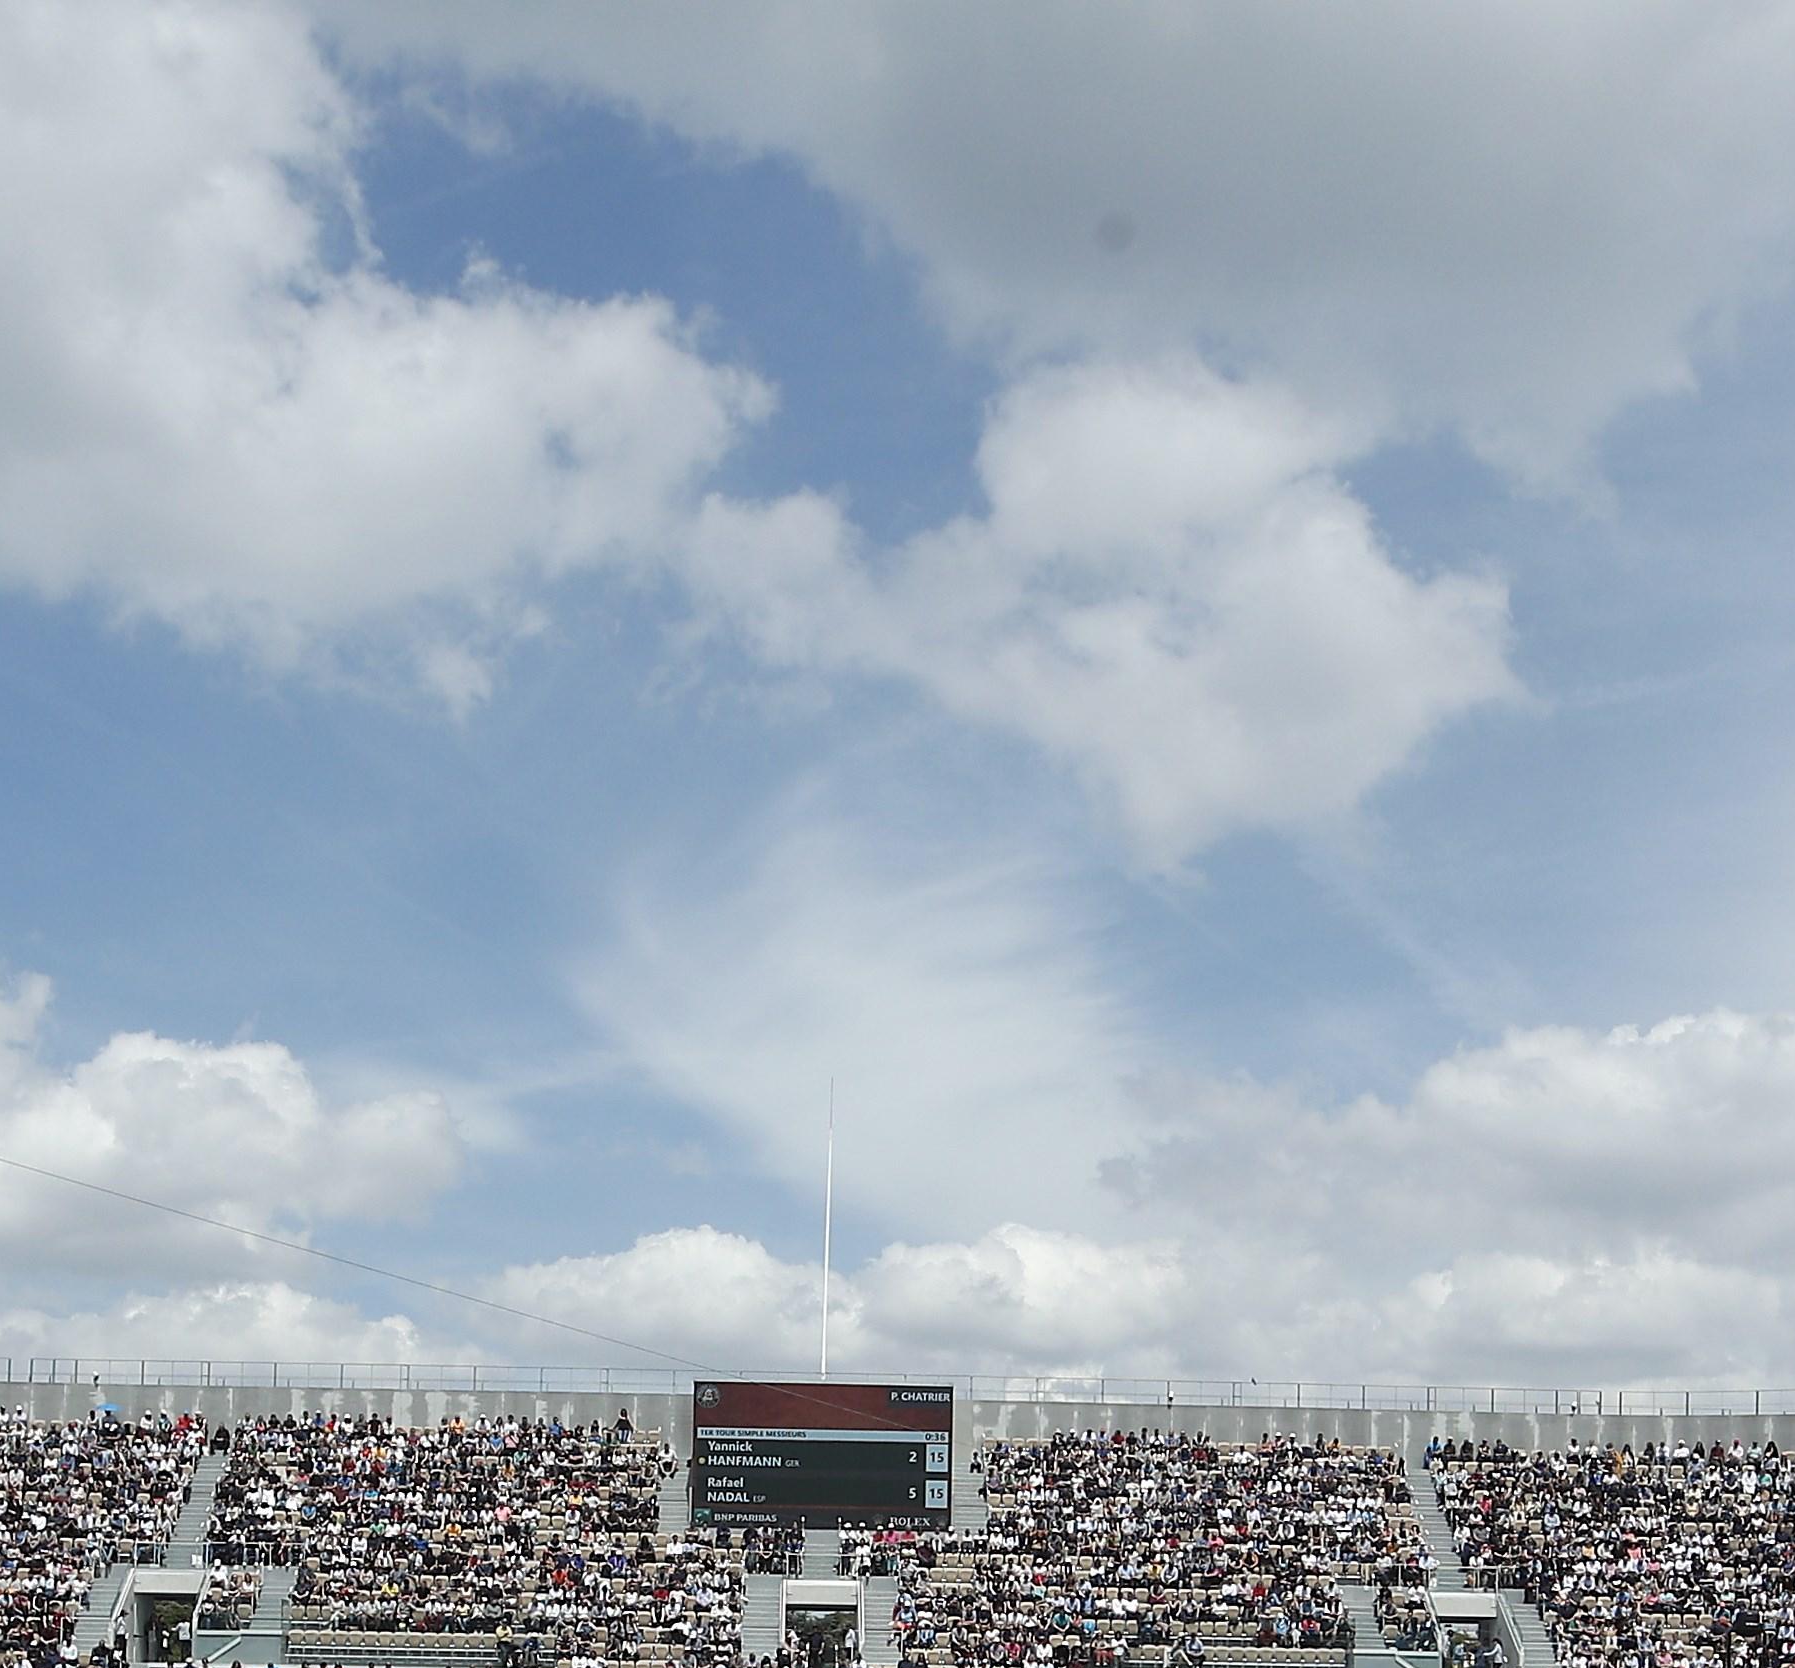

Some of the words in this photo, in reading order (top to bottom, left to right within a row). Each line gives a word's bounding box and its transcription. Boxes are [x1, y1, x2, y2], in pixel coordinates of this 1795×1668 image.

[890, 1391, 900, 1402] P.
[901, 1391, 950, 1402] CHATRIER
[765, 1430, 807, 1438] MESSIEURS
[924, 1432, 946, 1441] 0:36
[707, 1440, 753, 1452] Yannick
[707, 1455, 782, 1467] HANFMANN
[784, 1459, 801, 1468] GER
[908, 1451, 918, 1463] 2
[929, 1451, 945, 1463] 15
[707, 1476, 744, 1488] Rafael
[707, 1491, 750, 1503] NADAL
[908, 1487, 917, 1499] 5
[929, 1488, 944, 1499] 15
[713, 1513, 735, 1521] BNP
[736, 1513, 778, 1522] PARIBAS
[889, 1516, 931, 1527] ROLEX
